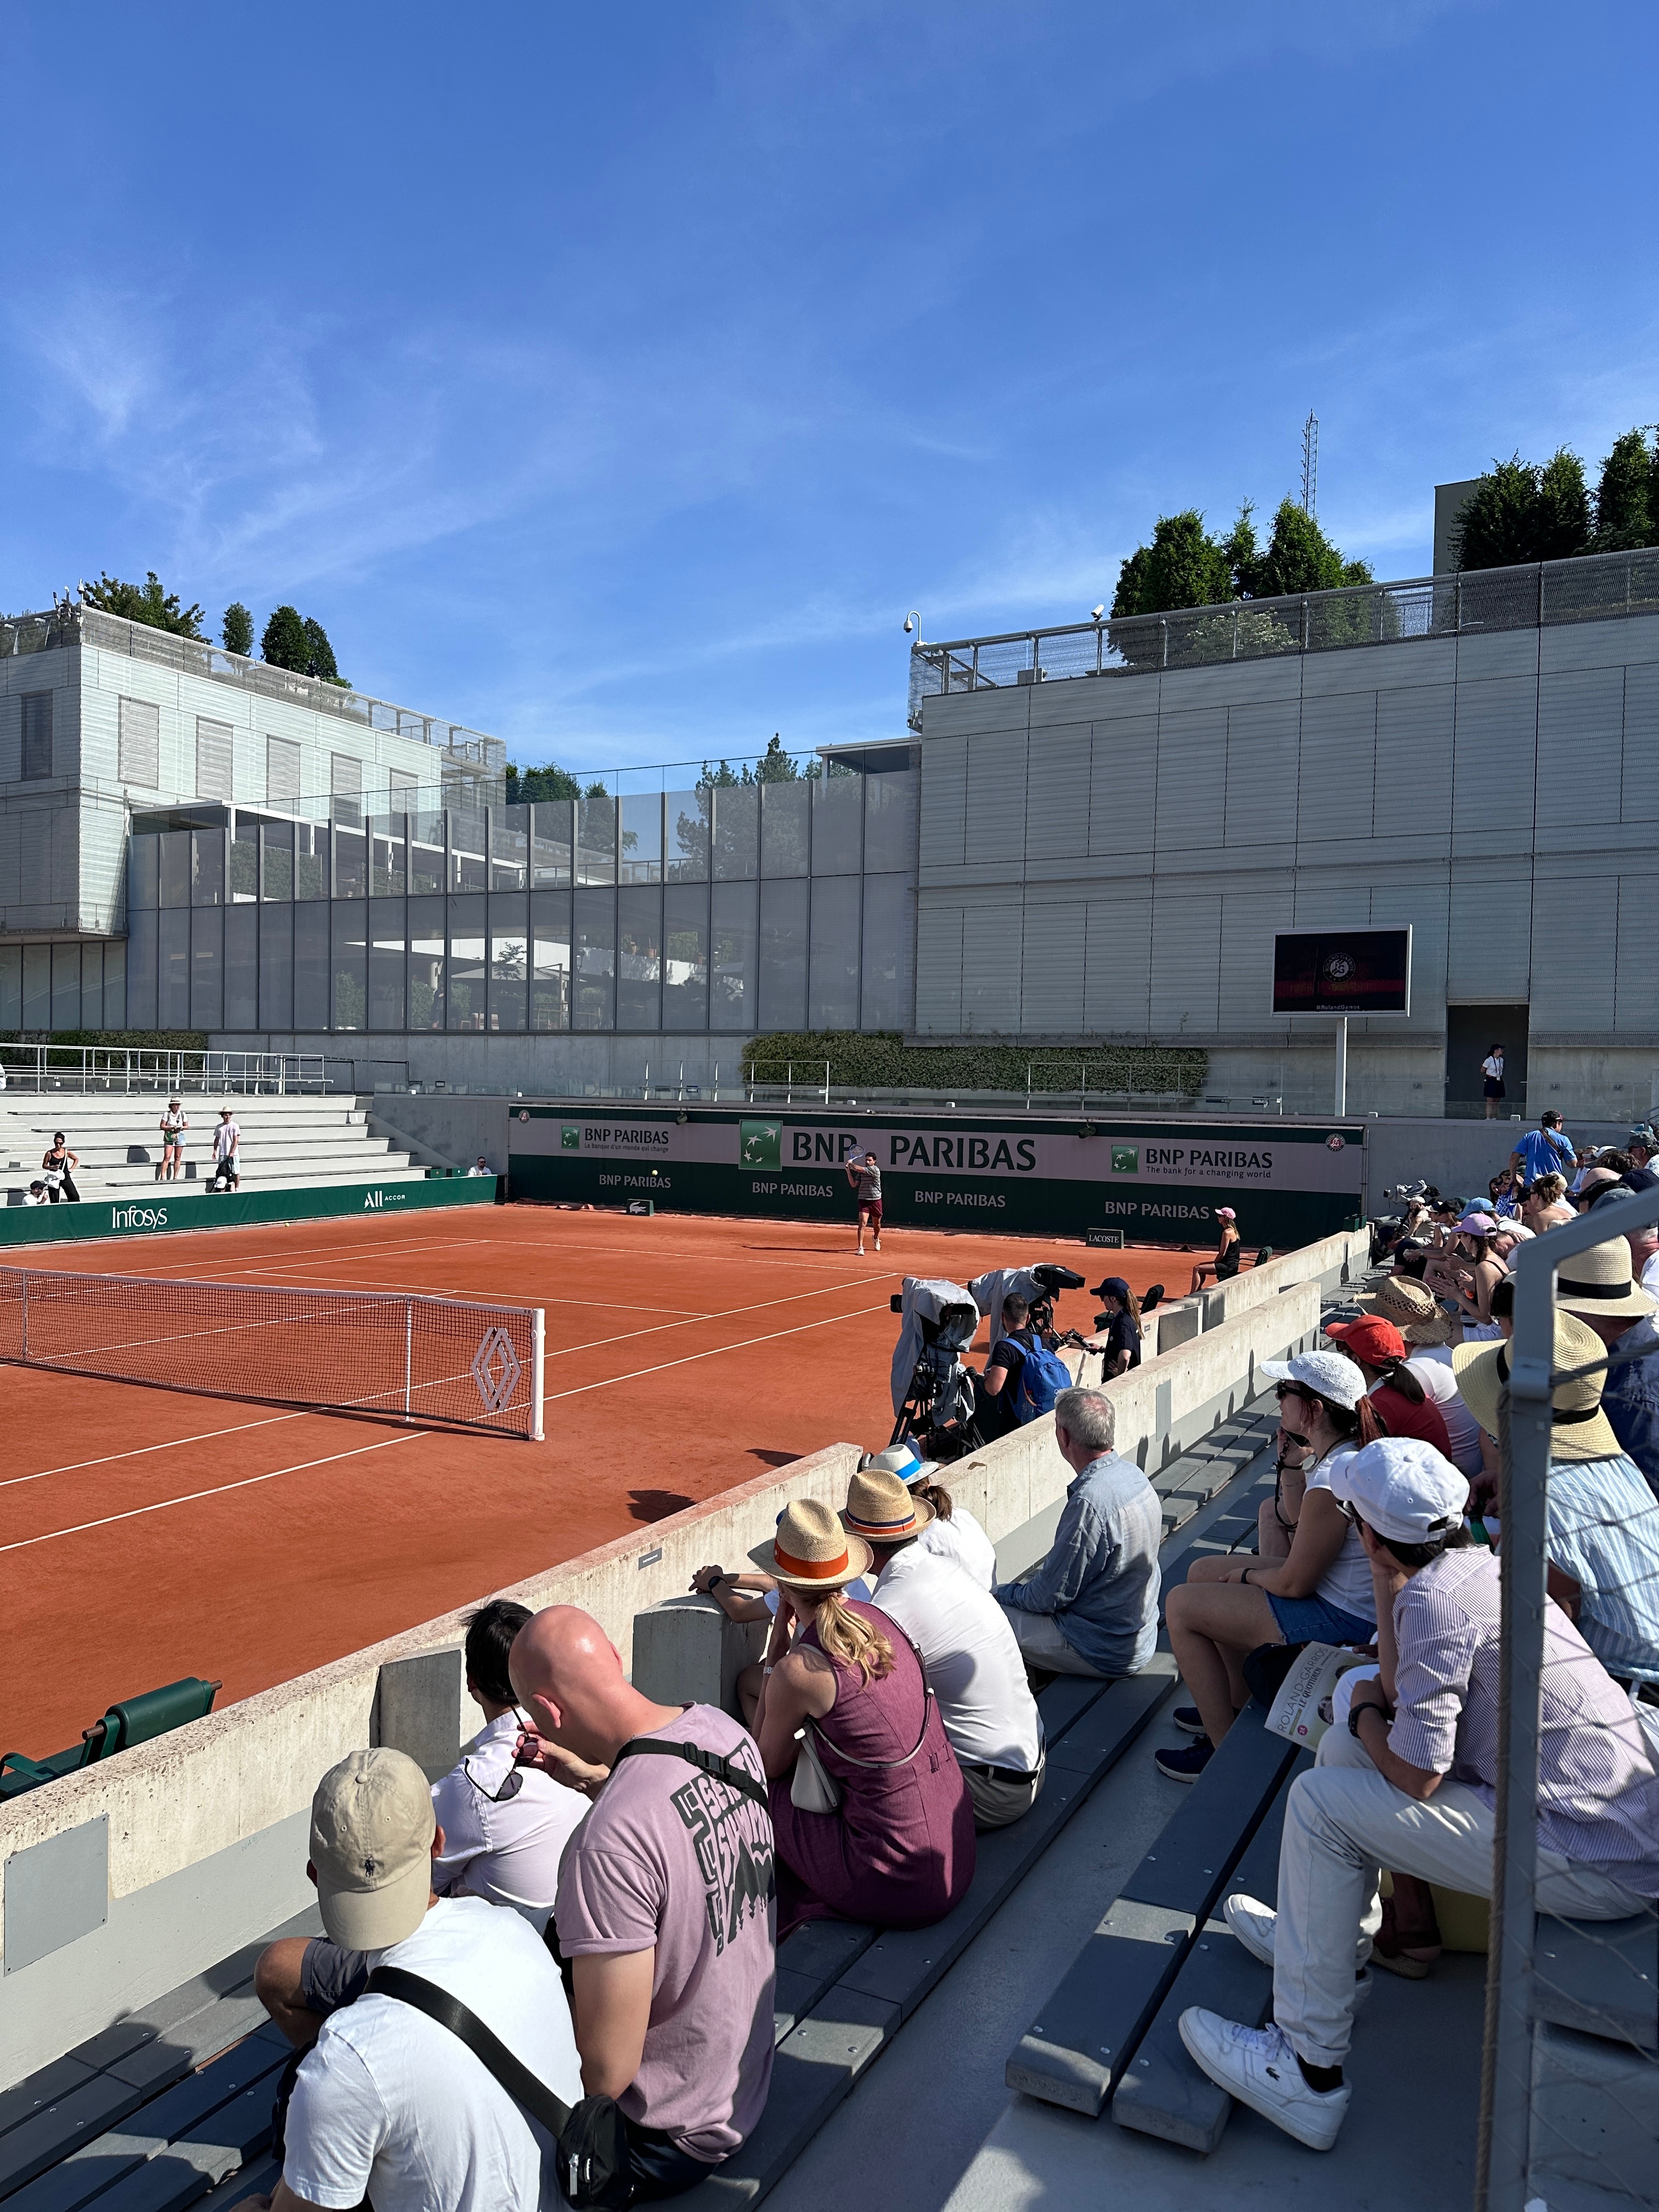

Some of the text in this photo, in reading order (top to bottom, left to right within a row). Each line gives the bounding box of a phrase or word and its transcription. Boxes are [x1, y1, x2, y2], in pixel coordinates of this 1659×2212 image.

[585, 1128, 669, 1144] BNP PARIBAS
[793, 1132, 1036, 1171] BNP PARIBAS
[1146, 1148, 1273, 1169] BNP PARIBAS
[599, 1174, 672, 1188] BNP PARIBAS
[1163, 1166, 1182, 1175] bank
[1184, 1167, 1197, 1176] for
[1206, 1169, 1244, 1179] changing
[752, 1182, 833, 1197] BNP PARIBAS
[915, 1190, 1006, 1207] BNP PARIBAS
[112, 1205, 167, 1229] Infosys
[1105, 1201, 1210, 1220] BNP PARIBAS
[1088, 1234, 1120, 1244] LACOSTE
[1277, 1647, 1328, 1733] ROLAND-GARROS
[1302, 1666, 1323, 1699] QUOTIDIEN
